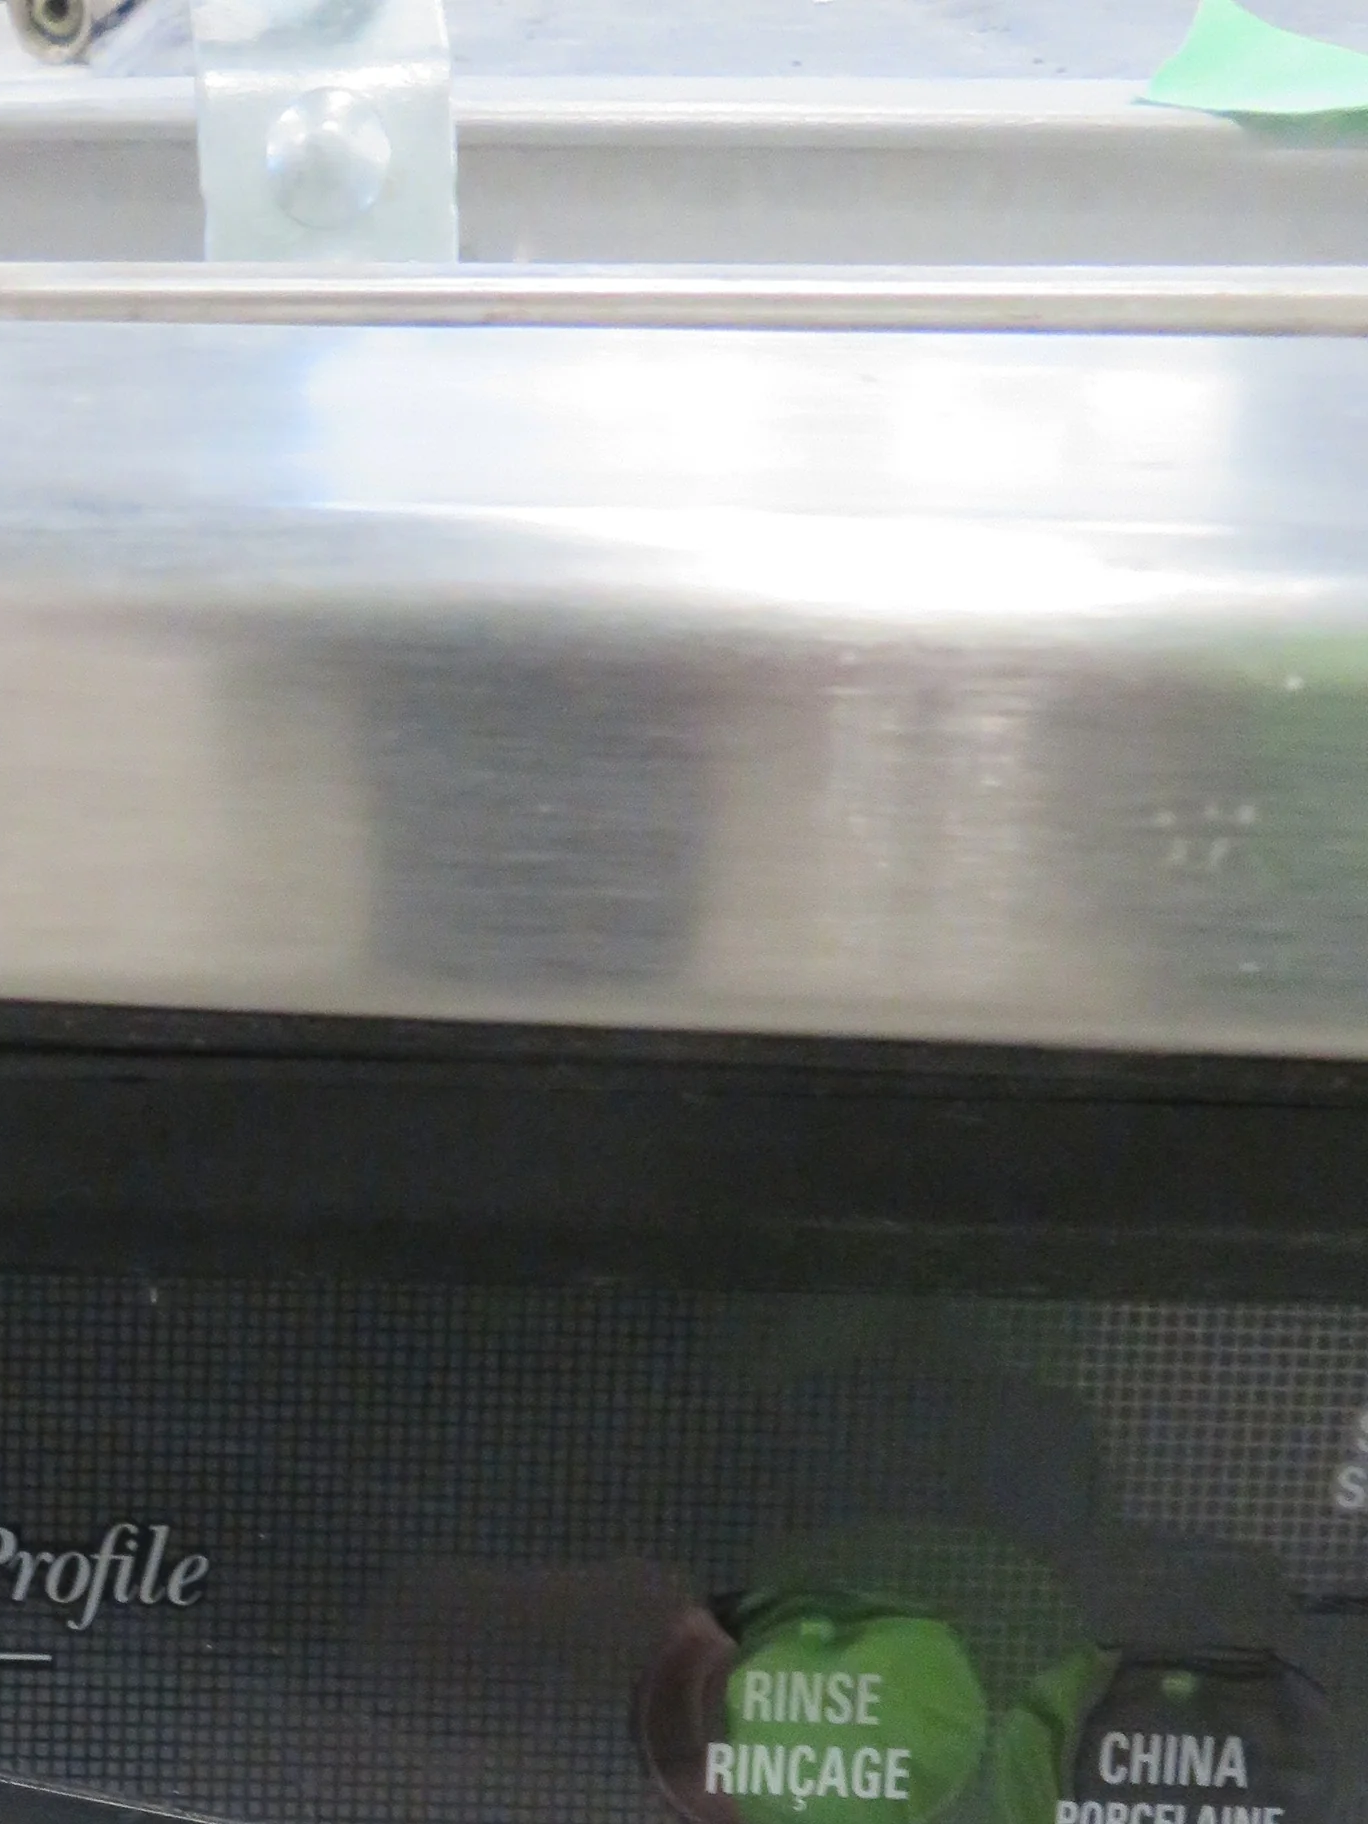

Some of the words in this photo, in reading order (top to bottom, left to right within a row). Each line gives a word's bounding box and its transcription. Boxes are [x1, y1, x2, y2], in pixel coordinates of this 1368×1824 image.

[742, 1670, 882, 1726] RINSE
[705, 1742, 912, 1812] RINÇAGE
[1098, 1731, 1248, 1789] CHINA
